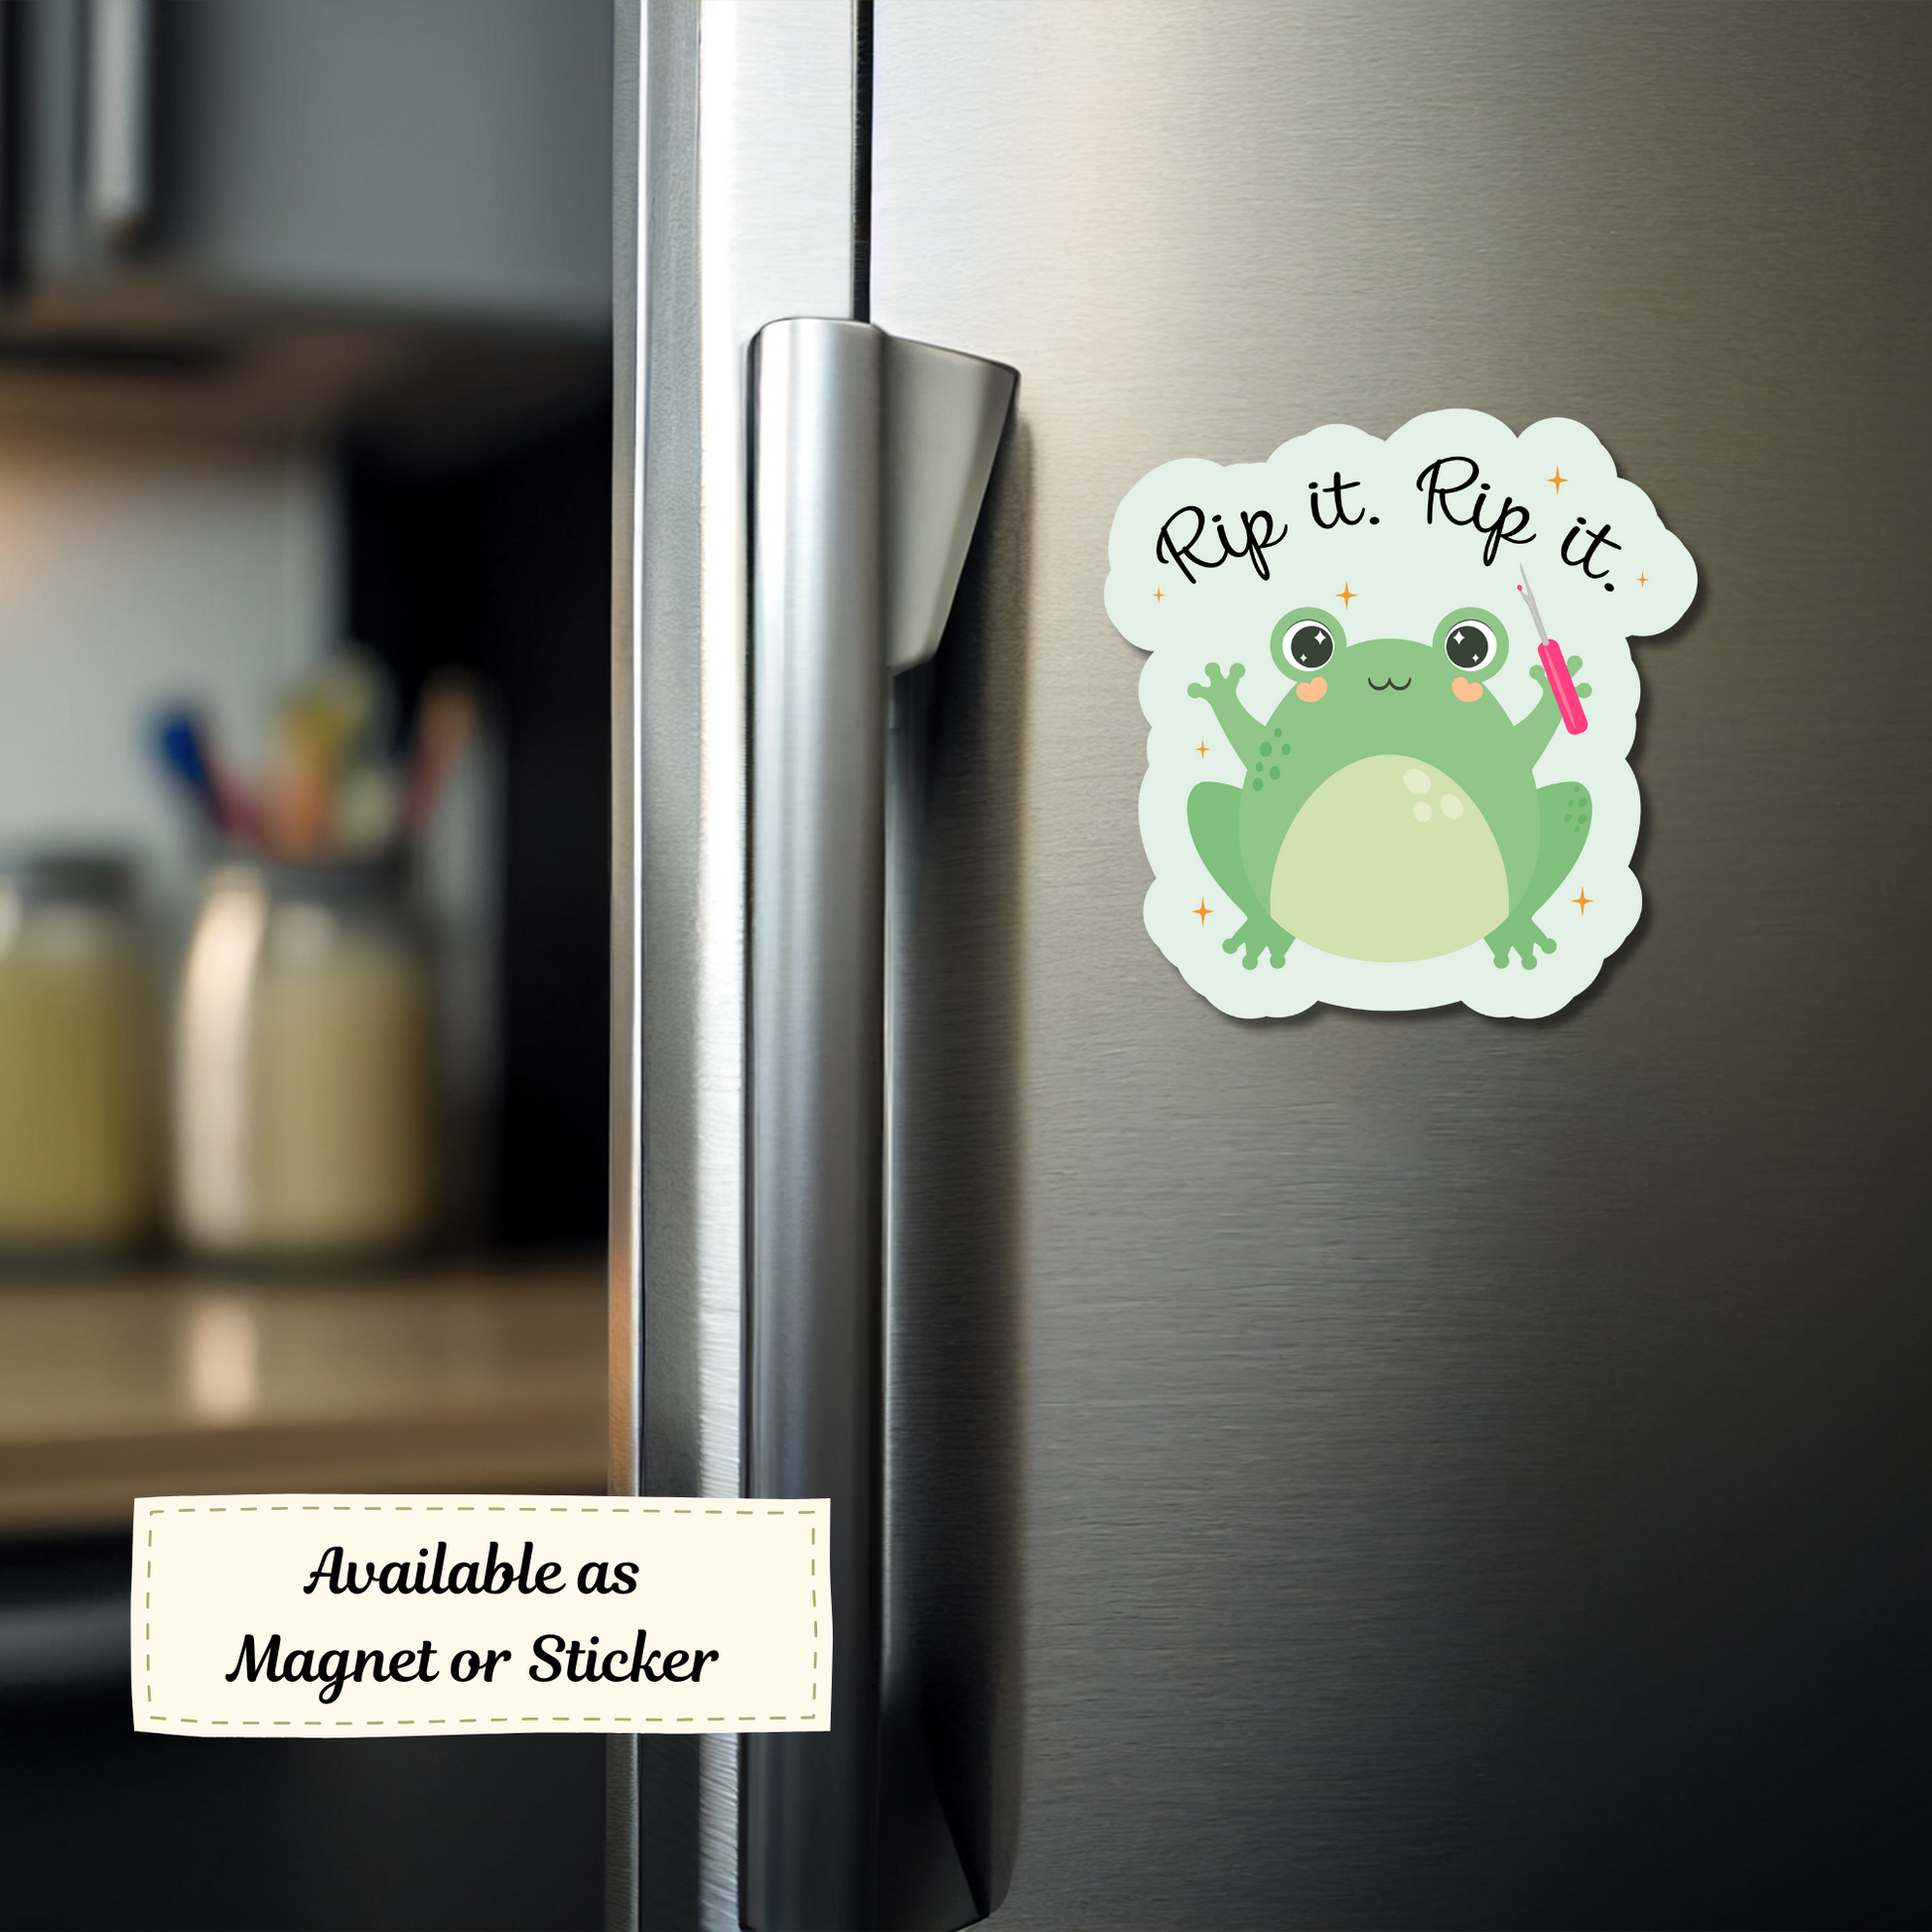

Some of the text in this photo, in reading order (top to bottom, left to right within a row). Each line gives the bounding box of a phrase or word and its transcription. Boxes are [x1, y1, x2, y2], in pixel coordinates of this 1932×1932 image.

[1156, 456, 1622, 593] Rip it. Rip it.
